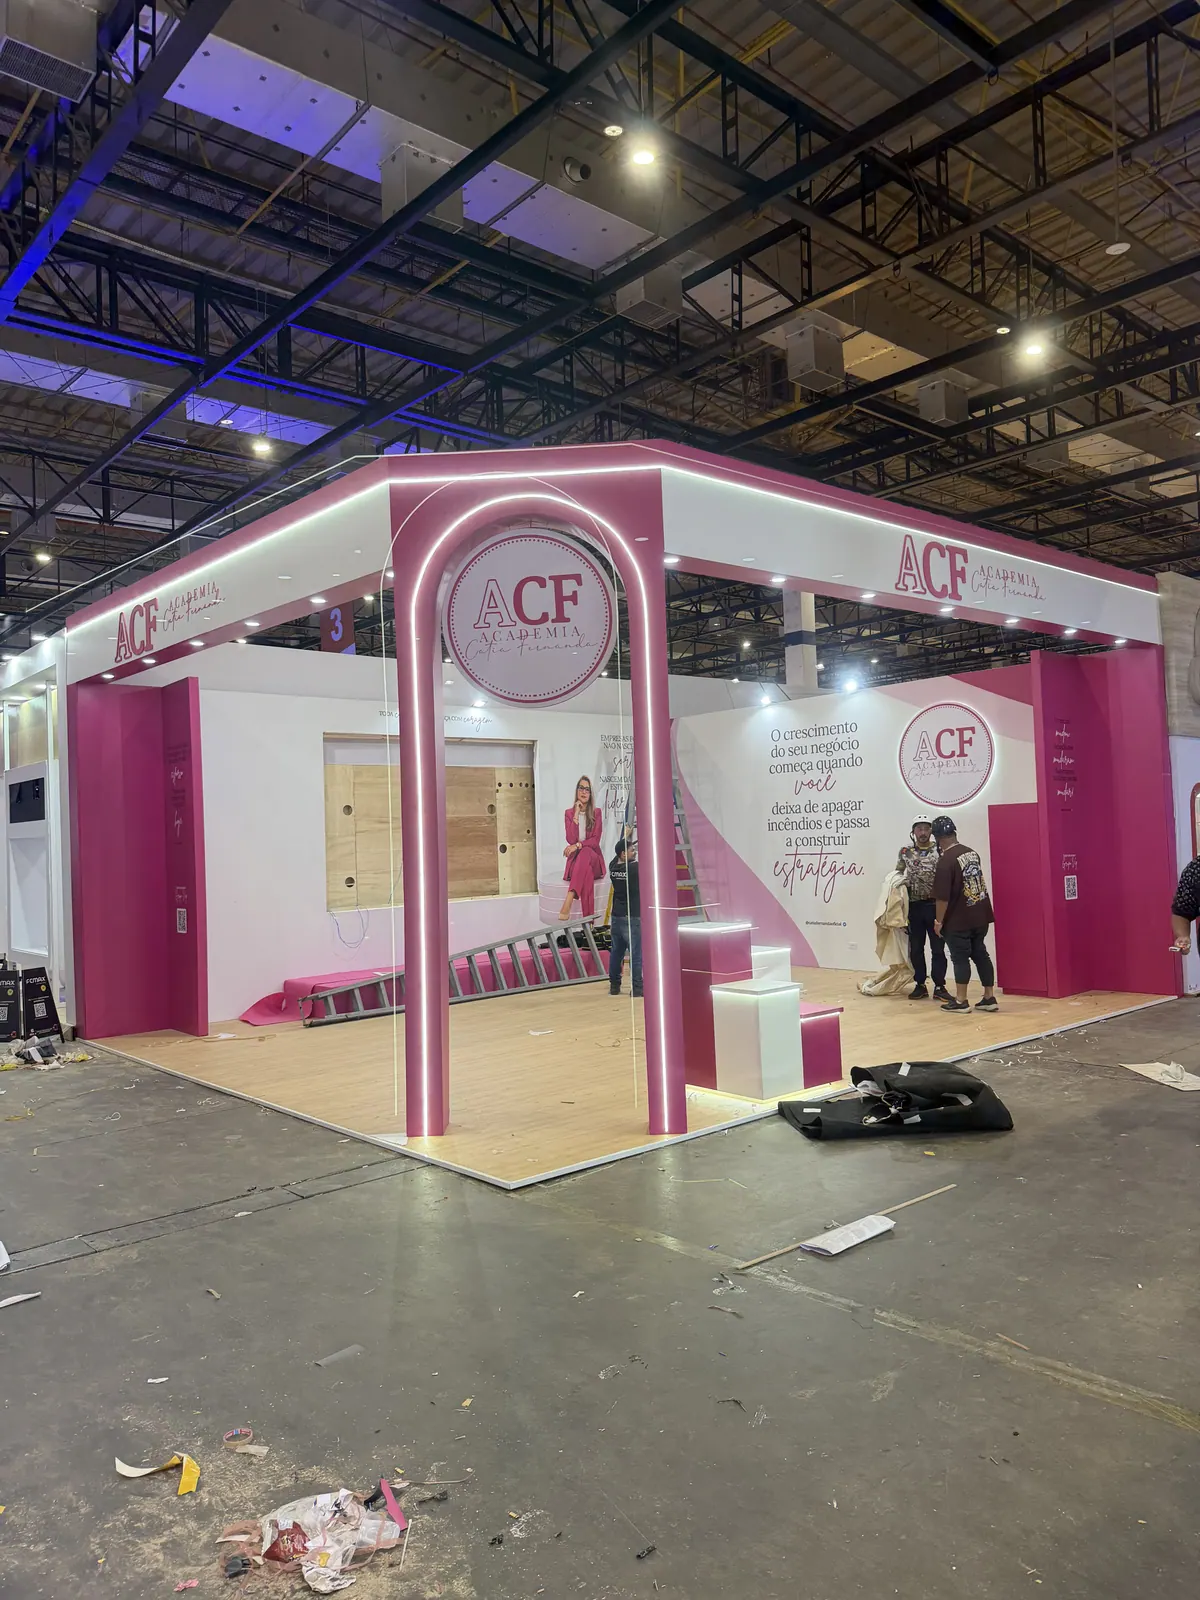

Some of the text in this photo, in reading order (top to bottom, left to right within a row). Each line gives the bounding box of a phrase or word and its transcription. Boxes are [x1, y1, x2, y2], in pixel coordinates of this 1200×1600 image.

[895, 534, 968, 600] ACF
[979, 565, 1037, 587] ACADEMIA
[169, 581, 218, 612] ACADEMIA
[473, 573, 583, 629] ACF
[114, 597, 158, 663] ACF
[330, 607, 343, 642] 3
[479, 626, 581, 643] ACADEMIA
[600, 734, 630, 743] EMPRESAS
[770, 721, 858, 742] O crescimento
[616, 742, 633, 750] NASCE
[770, 737, 860, 758] do seu negócio
[912, 726, 976, 761] ACF
[769, 753, 863, 775] começa quando
[917, 759, 975, 770] ACADEMIA
[610, 783, 630, 791] ESTRAT
[794, 769, 837, 796] você
[771, 800, 864, 816] deixa de apagar
[768, 817, 870, 833] incêndios e passa
[785, 832, 850, 847] a construir
